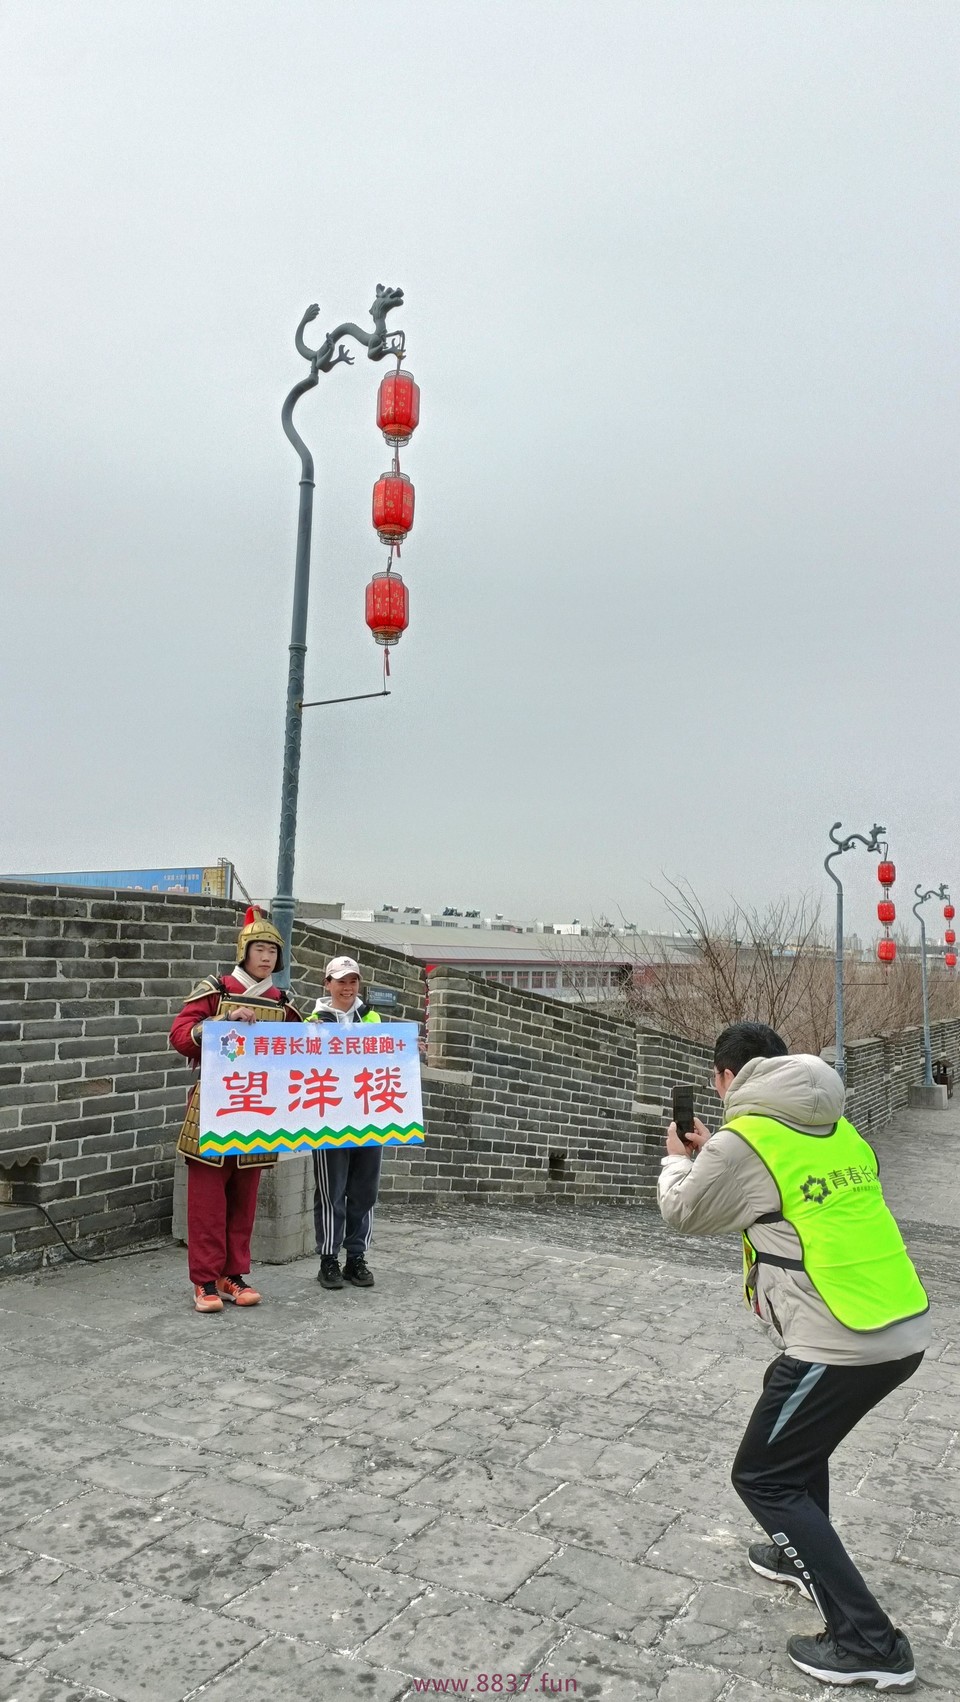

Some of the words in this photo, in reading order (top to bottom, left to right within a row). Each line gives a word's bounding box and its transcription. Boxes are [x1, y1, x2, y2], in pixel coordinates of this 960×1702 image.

[253, 1036, 322, 1056] 青春长城
[327, 1036, 407, 1055] 全民健跑+
[215, 1066, 408, 1118] 望洋楼
